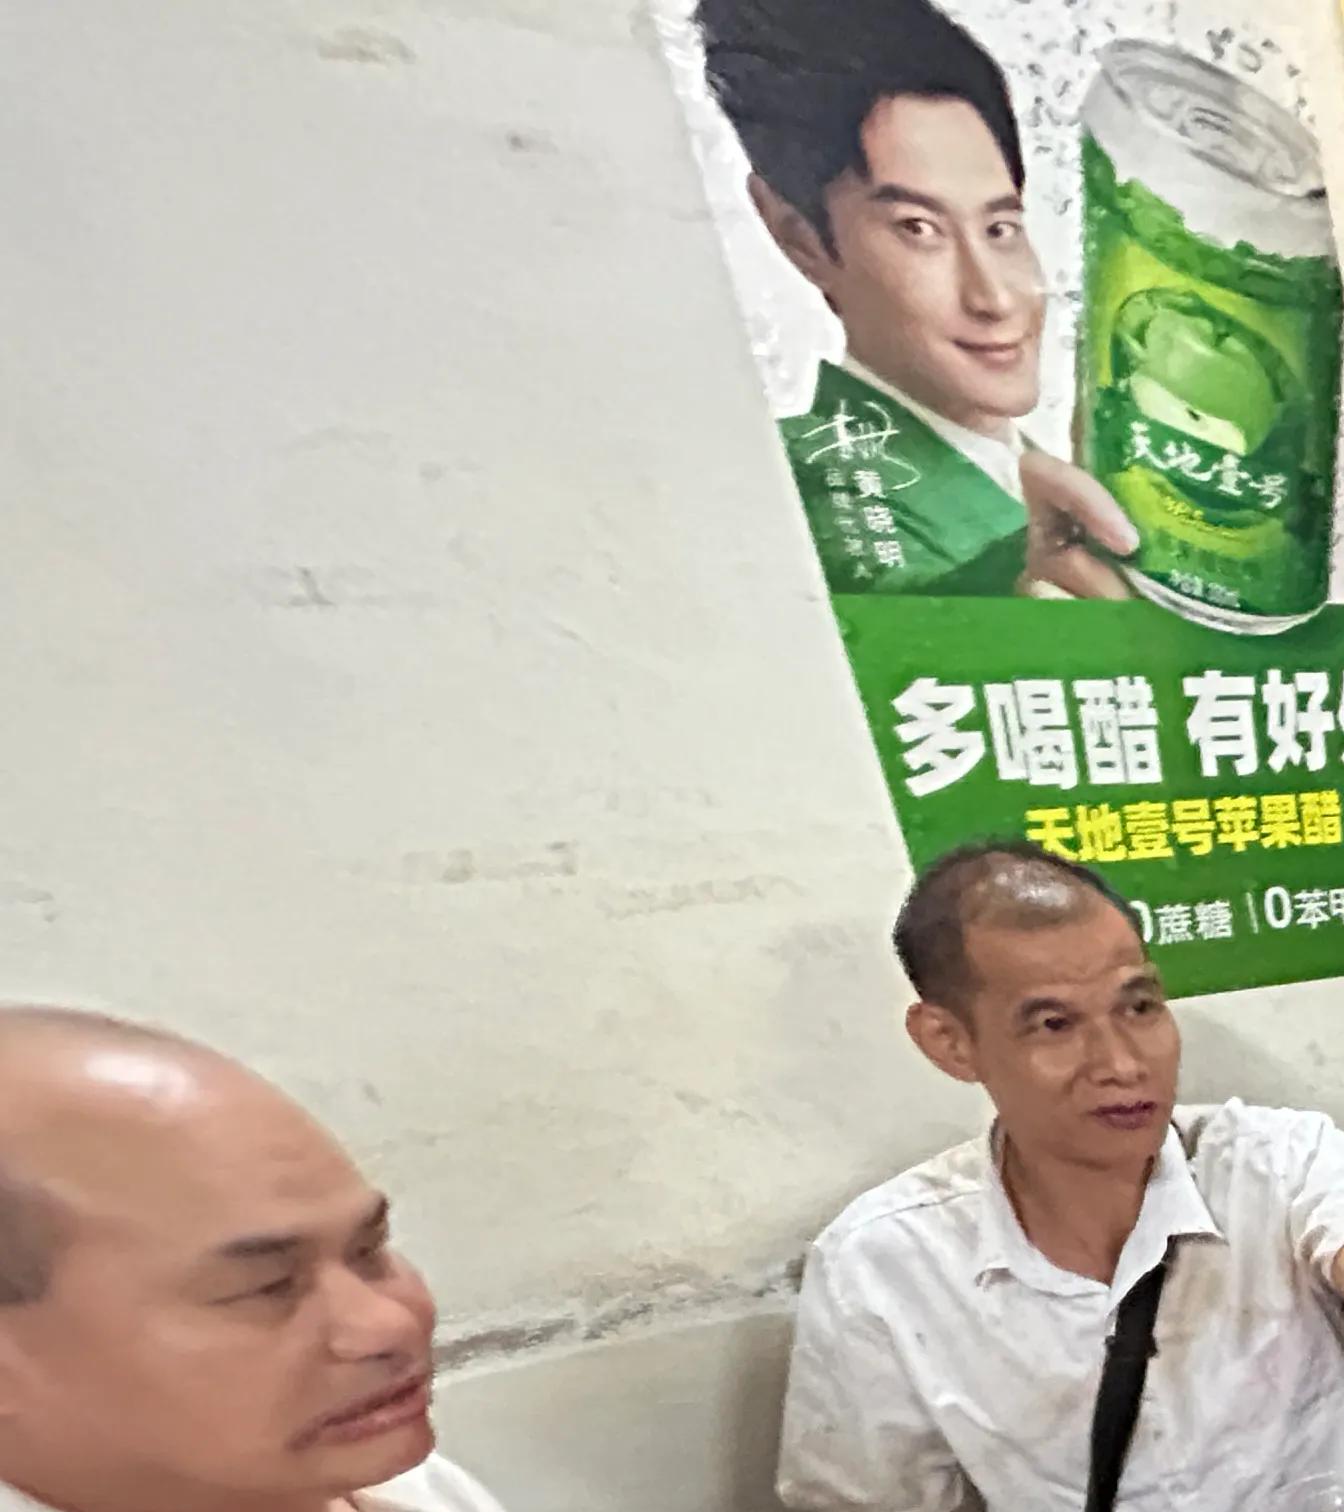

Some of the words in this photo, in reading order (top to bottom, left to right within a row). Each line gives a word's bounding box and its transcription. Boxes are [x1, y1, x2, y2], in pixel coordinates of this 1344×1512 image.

[891, 677, 1164, 799] 多喝醋
[1025, 789, 1342, 863] 天地壹号苹果醋
